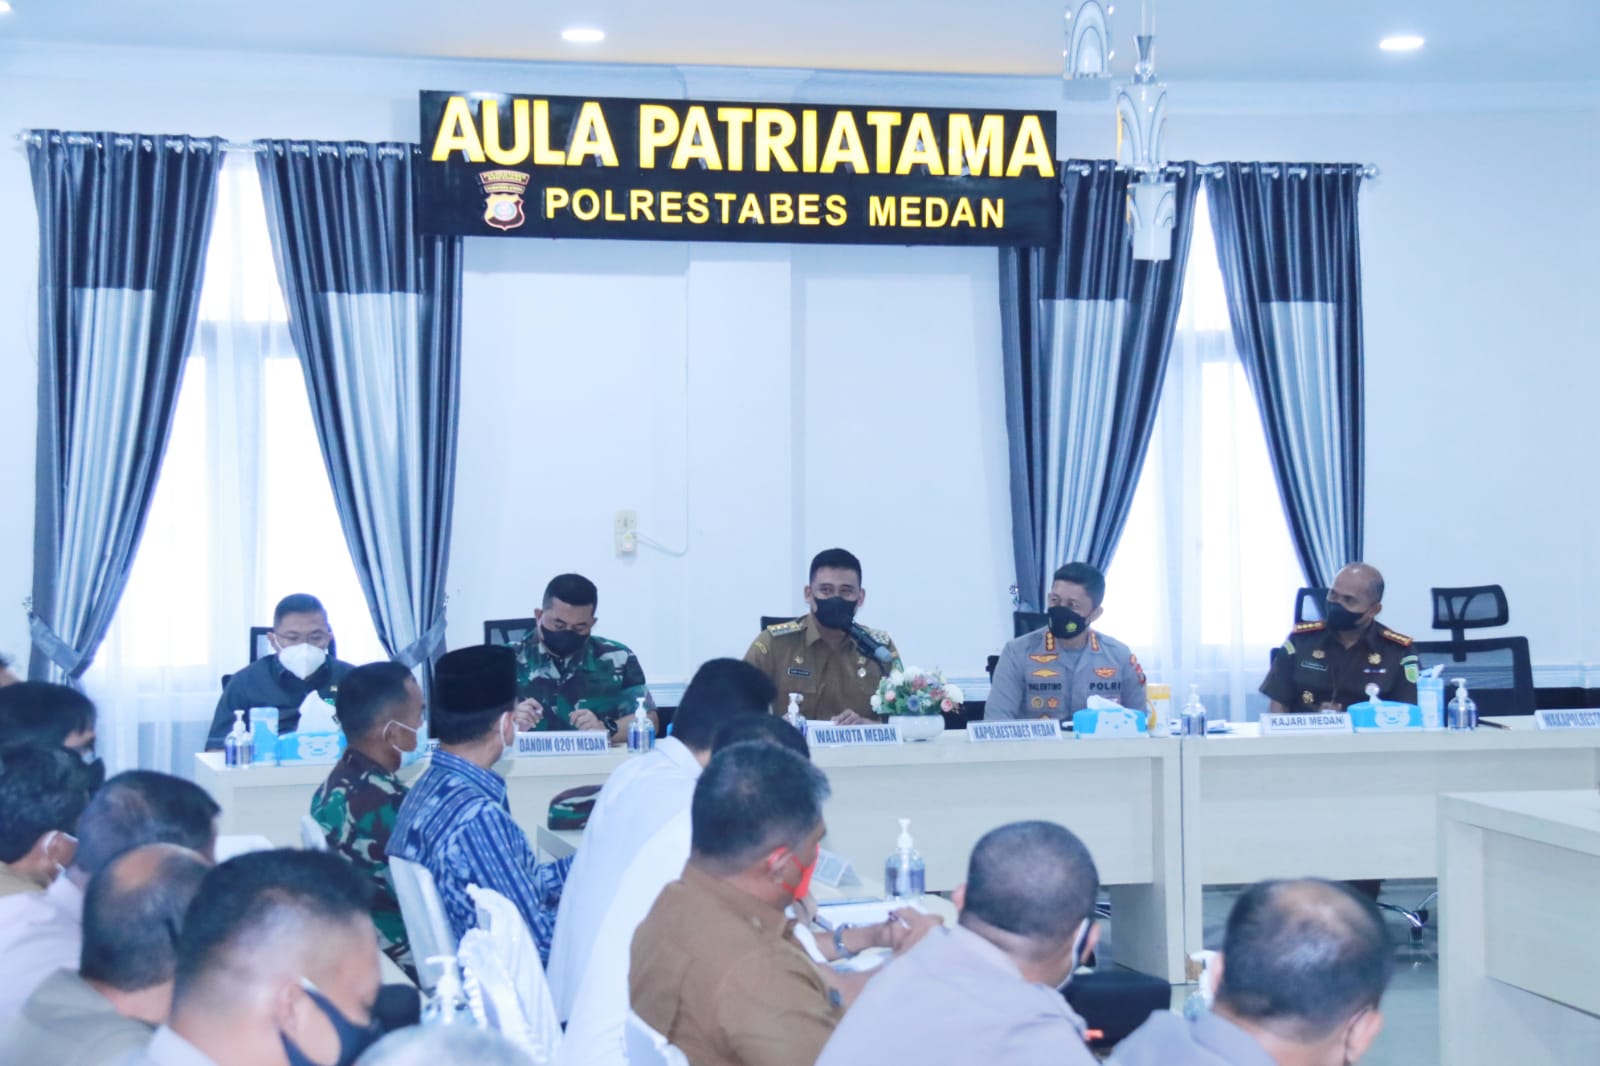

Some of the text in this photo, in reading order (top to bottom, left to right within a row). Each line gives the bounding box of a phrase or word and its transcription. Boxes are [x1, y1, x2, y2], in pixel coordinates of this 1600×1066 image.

[431, 95, 1056, 179] AULA PATRIATAMA
[545, 186, 1006, 229] POLRESTABES MEDAN
[1028, 682, 1062, 691] VALENTINO
[1089, 682, 1121, 691] POLRI
[1271, 715, 1343, 727] KAJARI MEDAN
[815, 727, 897, 744] WALIKOTA MEDAN
[974, 722, 1056, 739] KAPOLRESTABES MEDAN
[519, 736, 606, 753] DANDIM 0201 MEDAN
